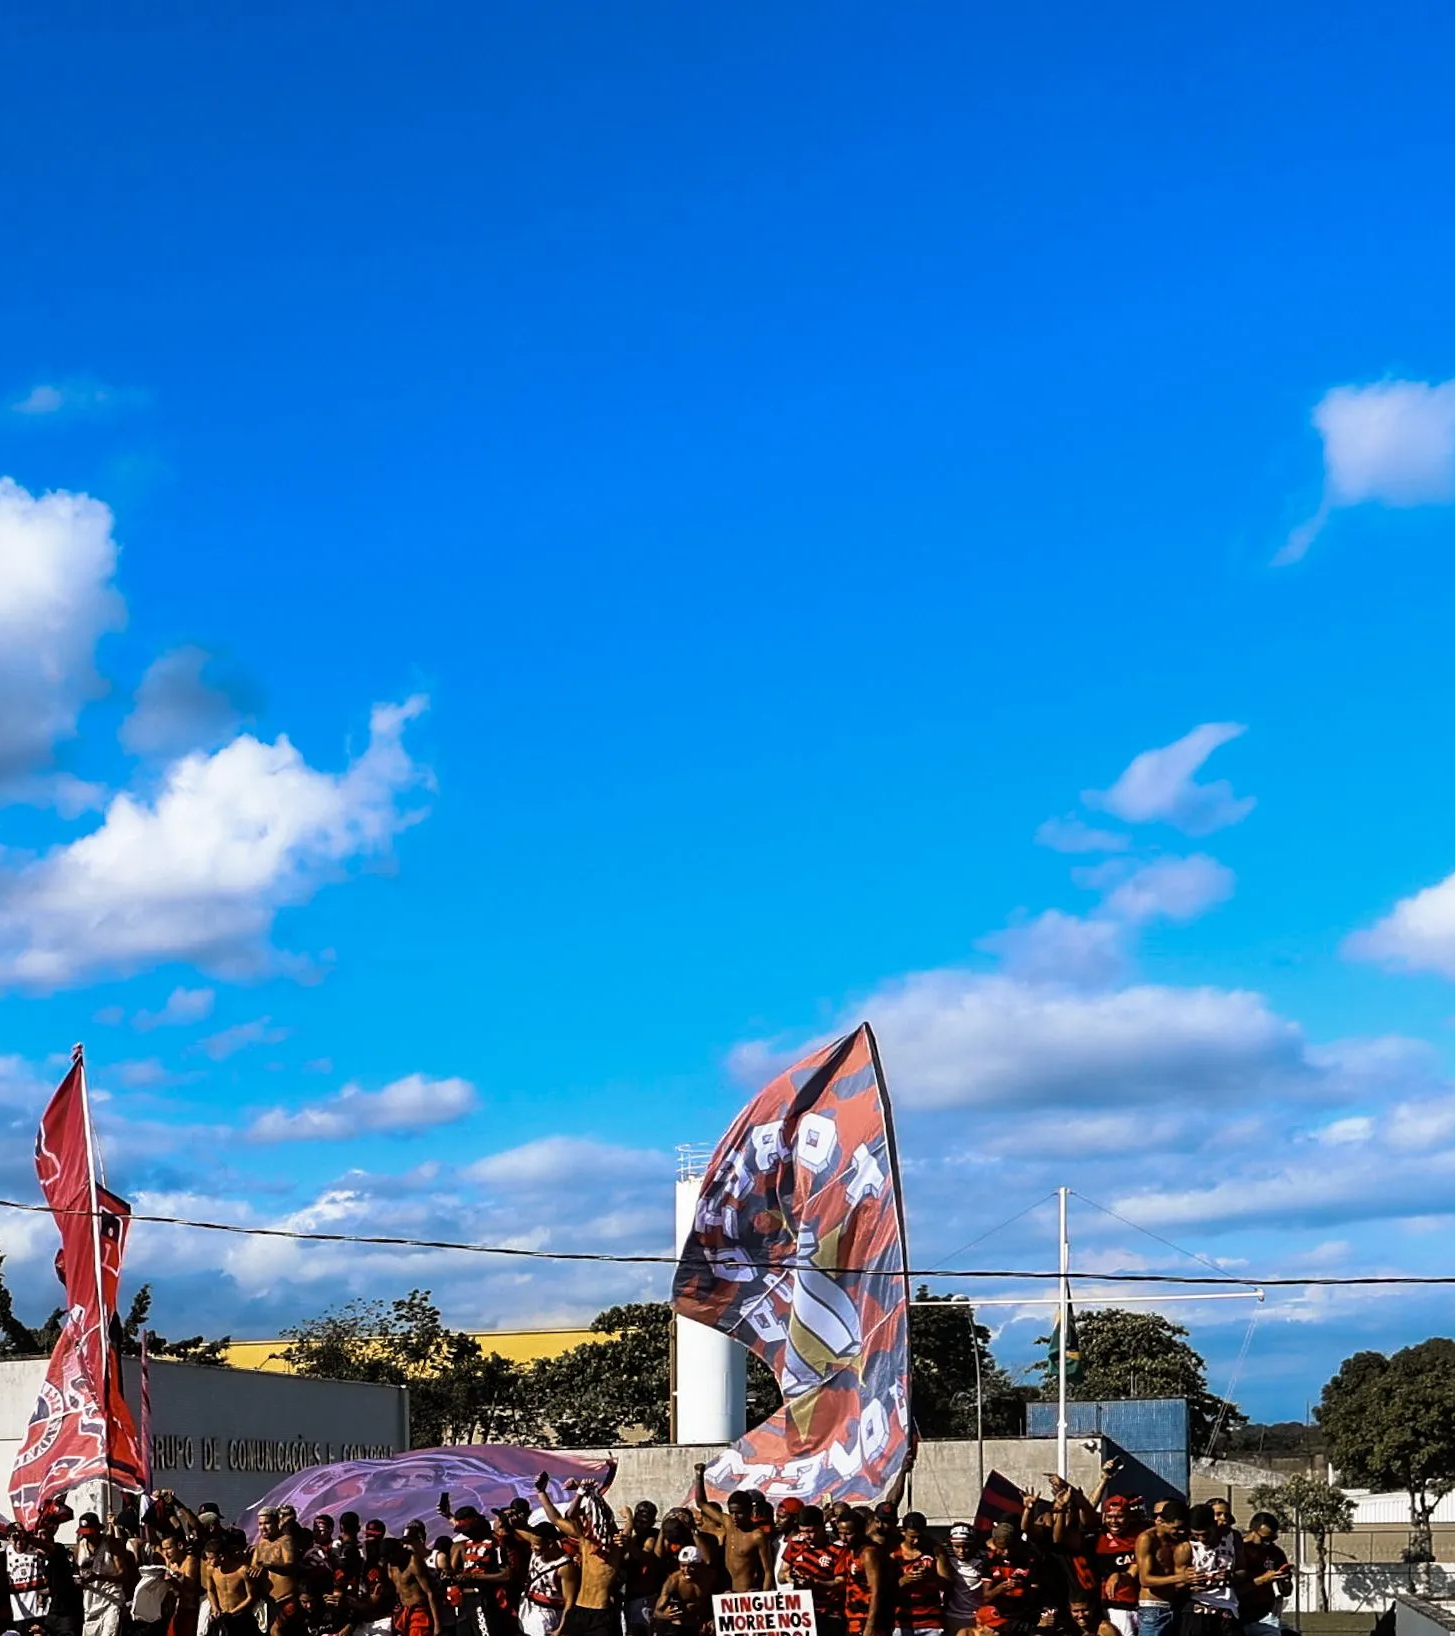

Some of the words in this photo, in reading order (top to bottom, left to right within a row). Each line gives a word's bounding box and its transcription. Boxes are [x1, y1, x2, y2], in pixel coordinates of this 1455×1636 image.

[151, 1433, 195, 1470] RUPO
[201, 1436, 222, 1472] DE
[720, 1591, 802, 1614] NINGUÉM
[718, 1613, 776, 1632] MORRE
[777, 1611, 812, 1628] NOS
